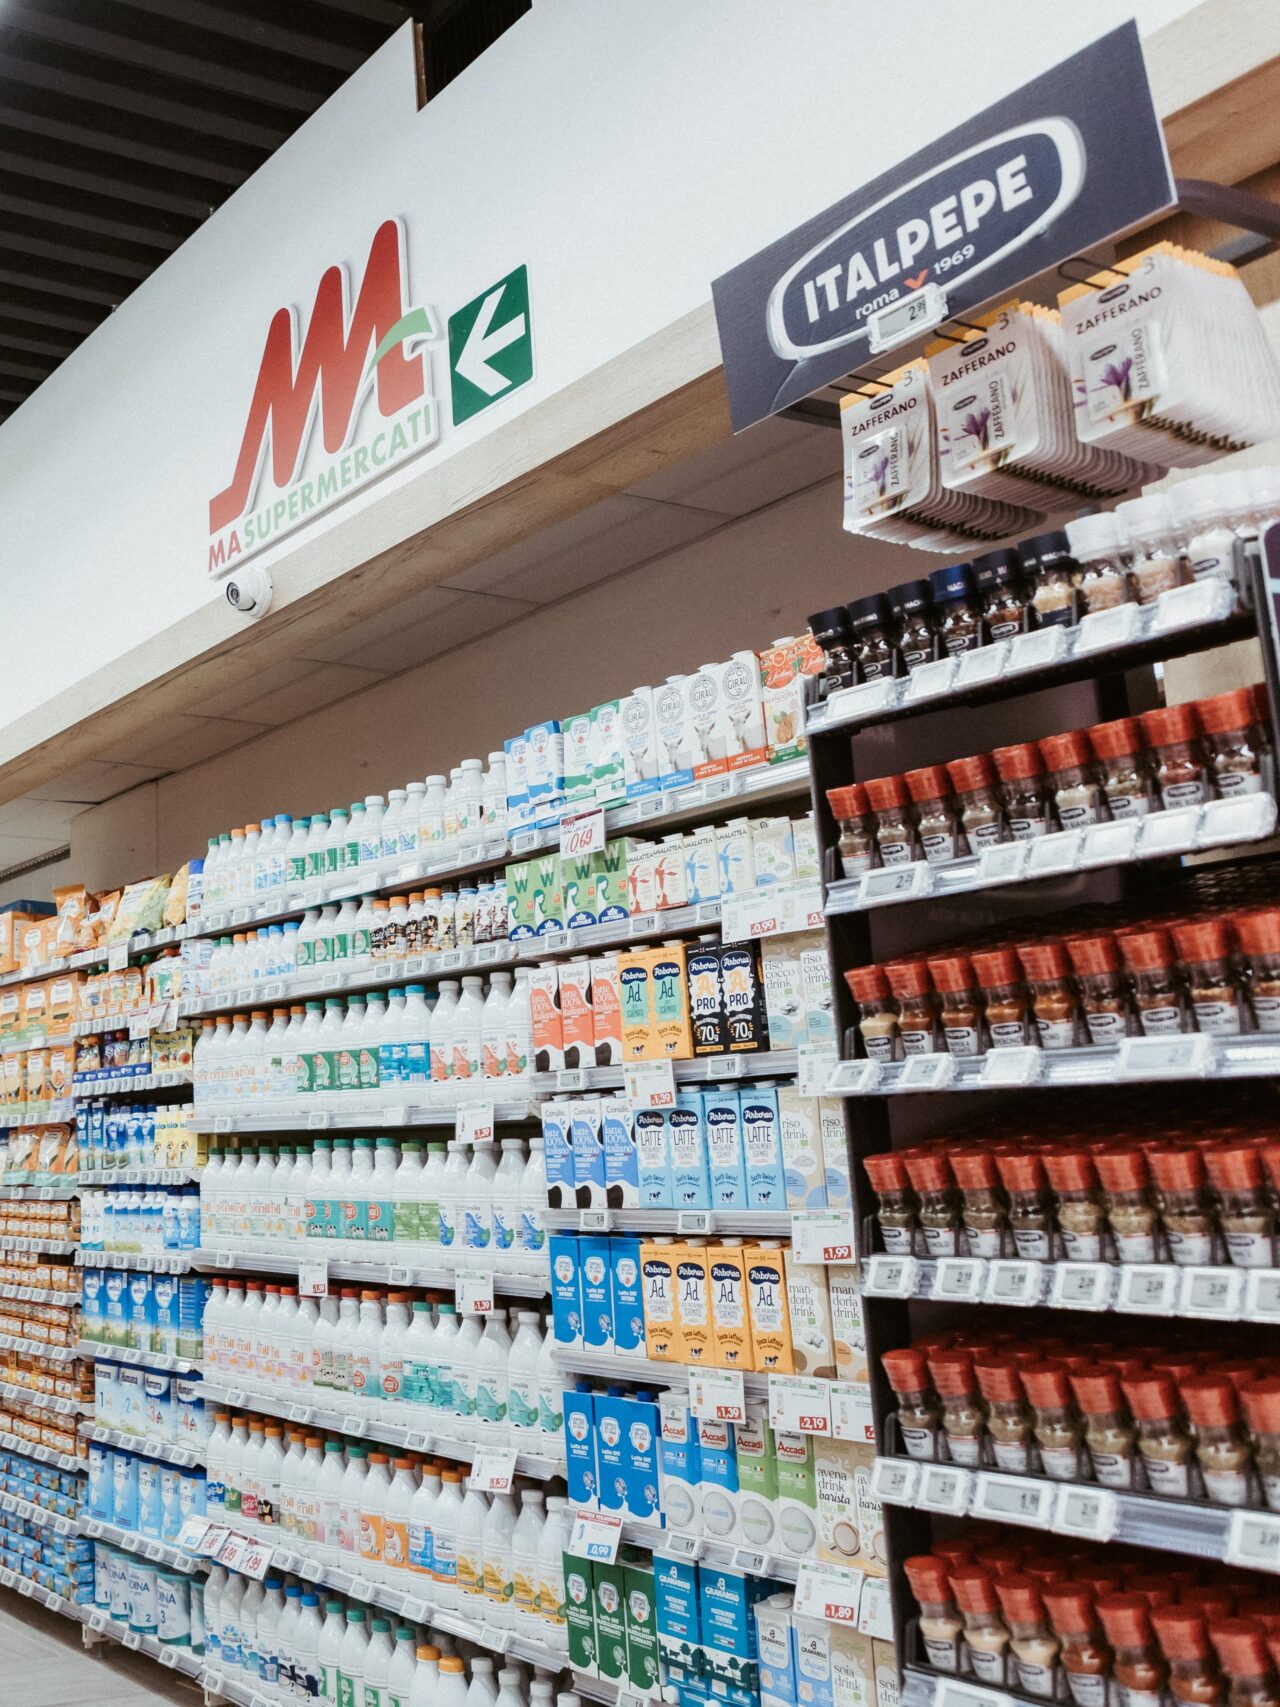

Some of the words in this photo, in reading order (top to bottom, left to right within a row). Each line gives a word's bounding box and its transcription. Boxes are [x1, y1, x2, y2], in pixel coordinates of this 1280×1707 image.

[804, 154, 1033, 323] ITALPEPE
[934, 244, 975, 274] 1969
[855, 289, 899, 319] roma
[1075, 286, 1162, 335] ZAFFERANO
[941, 341, 1016, 386] ZAFFERANO
[1131, 328, 1150, 389] ZAFFERANO
[989, 380, 1005, 440] ZAFFERANO
[851, 397, 917, 437] ZAFFERANO
[891, 432, 899, 486] ZAFFERANO
[727, 676, 748, 690] GIRAU
[723, 956, 750, 966] Arborea
[765, 960, 784, 971] riso
[803, 954, 821, 965] riso
[655, 967, 680, 976] Arborea
[691, 962, 717, 972] Arborea
[622, 971, 646, 981] Arborea
[765, 969, 795, 979] cocco
[766, 978, 792, 990] drink
[696, 997, 716, 1011] PRO
[729, 993, 749, 1006] PRO
[639, 1115, 663, 1124] Arborea
[671, 1113, 697, 1123] Arborea
[709, 1111, 735, 1121] Arborea
[745, 1109, 772, 1119] Arborea
[782, 1118, 800, 1129] riso
[822, 1116, 840, 1127] riso
[641, 1131, 661, 1146] LATTE
[674, 1130, 695, 1146] LATTE
[712, 1128, 734, 1144] LATTE
[747, 1126, 772, 1142] LATTE
[783, 1127, 808, 1139] drink
[825, 1247, 849, 1260] €1,99
[645, 1264, 670, 1274] Arborea
[678, 1266, 704, 1276] Arborea
[712, 1267, 741, 1278] Arborea
[750, 1270, 779, 1281] Arborea
[650, 1279, 666, 1299] Ad
[684, 1281, 700, 1301] Ad
[718, 1283, 735, 1303] Ad
[757, 1286, 774, 1307] Ad
[790, 1295, 814, 1306] dorla
[832, 1295, 858, 1307] dorla
[791, 1306, 816, 1317] drink
[833, 1307, 860, 1319] drink
[717, 1407, 738, 1420] €1,39
[801, 1417, 825, 1430] €2,19
[818, 1468, 847, 1481] avena
[818, 1479, 846, 1492] drink
[819, 1490, 851, 1505] barista
[826, 1605, 852, 1619] €1,89
[834, 1665, 854, 1678] soia
[835, 1676, 861, 1691] drink
